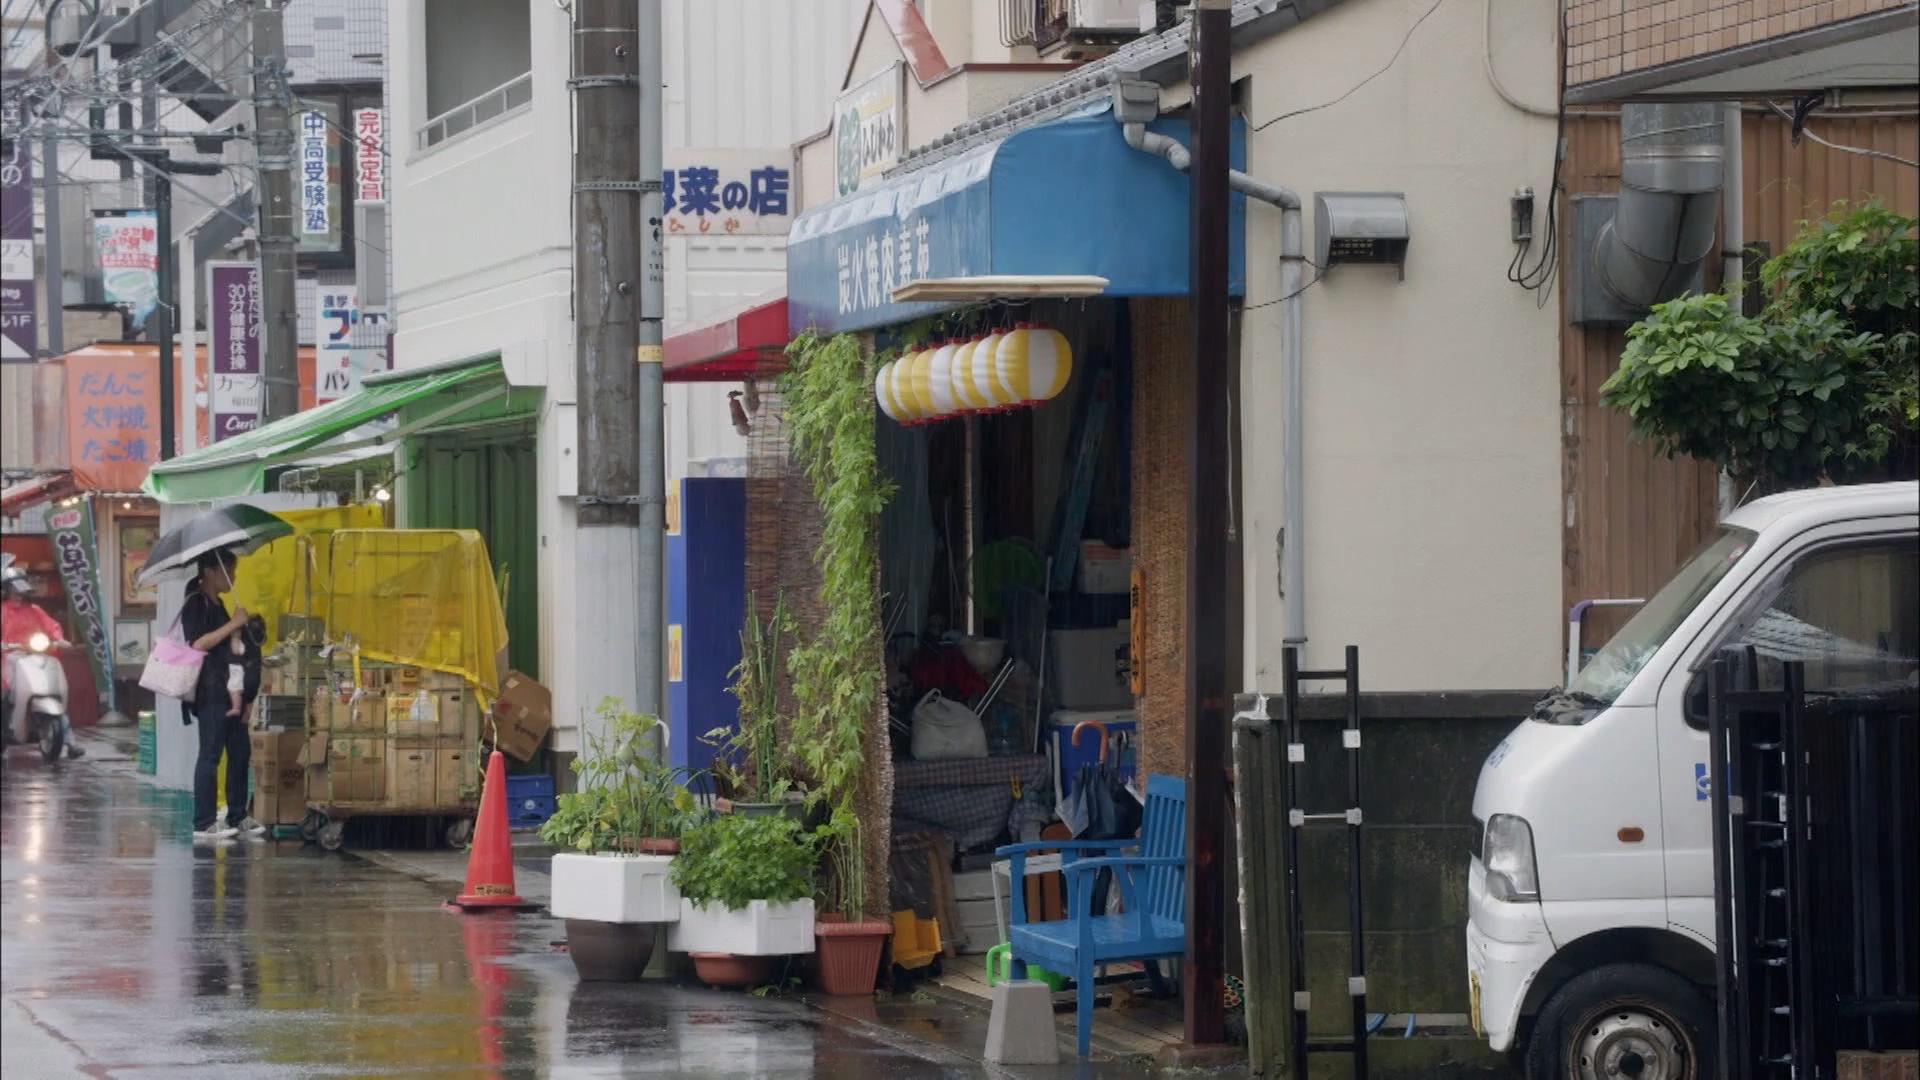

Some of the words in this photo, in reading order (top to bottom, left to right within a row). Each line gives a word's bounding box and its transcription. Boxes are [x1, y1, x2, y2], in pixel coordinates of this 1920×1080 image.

[304, 111, 326, 231] 中高受験塾
